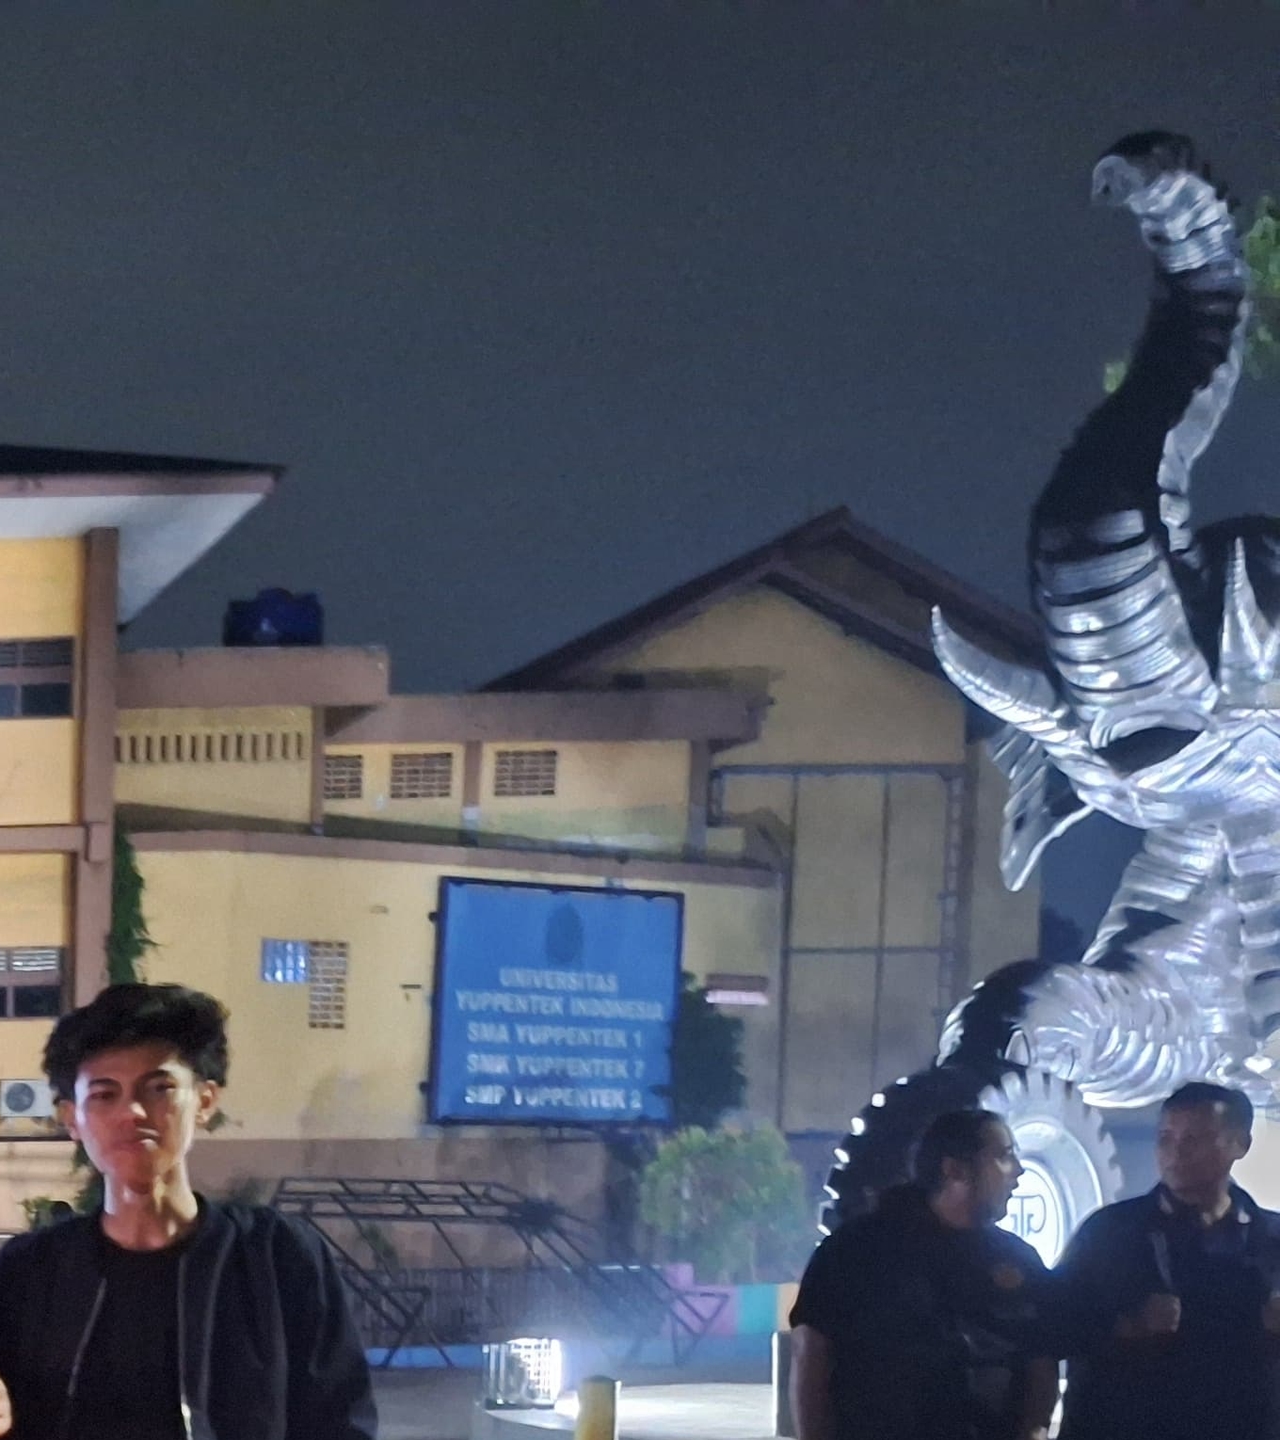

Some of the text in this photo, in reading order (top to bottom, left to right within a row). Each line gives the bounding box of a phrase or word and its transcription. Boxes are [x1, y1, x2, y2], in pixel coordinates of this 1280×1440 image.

[501, 969, 617, 991] UNIVERSITAS
[457, 992, 663, 1020] YUPPENTEK INDONESIA
[469, 1024, 508, 1043] SMA
[516, 1025, 626, 1047] YUPPENTEK
[516, 1057, 627, 1078] YUPPENTEK
[466, 1086, 506, 1104] SMP
